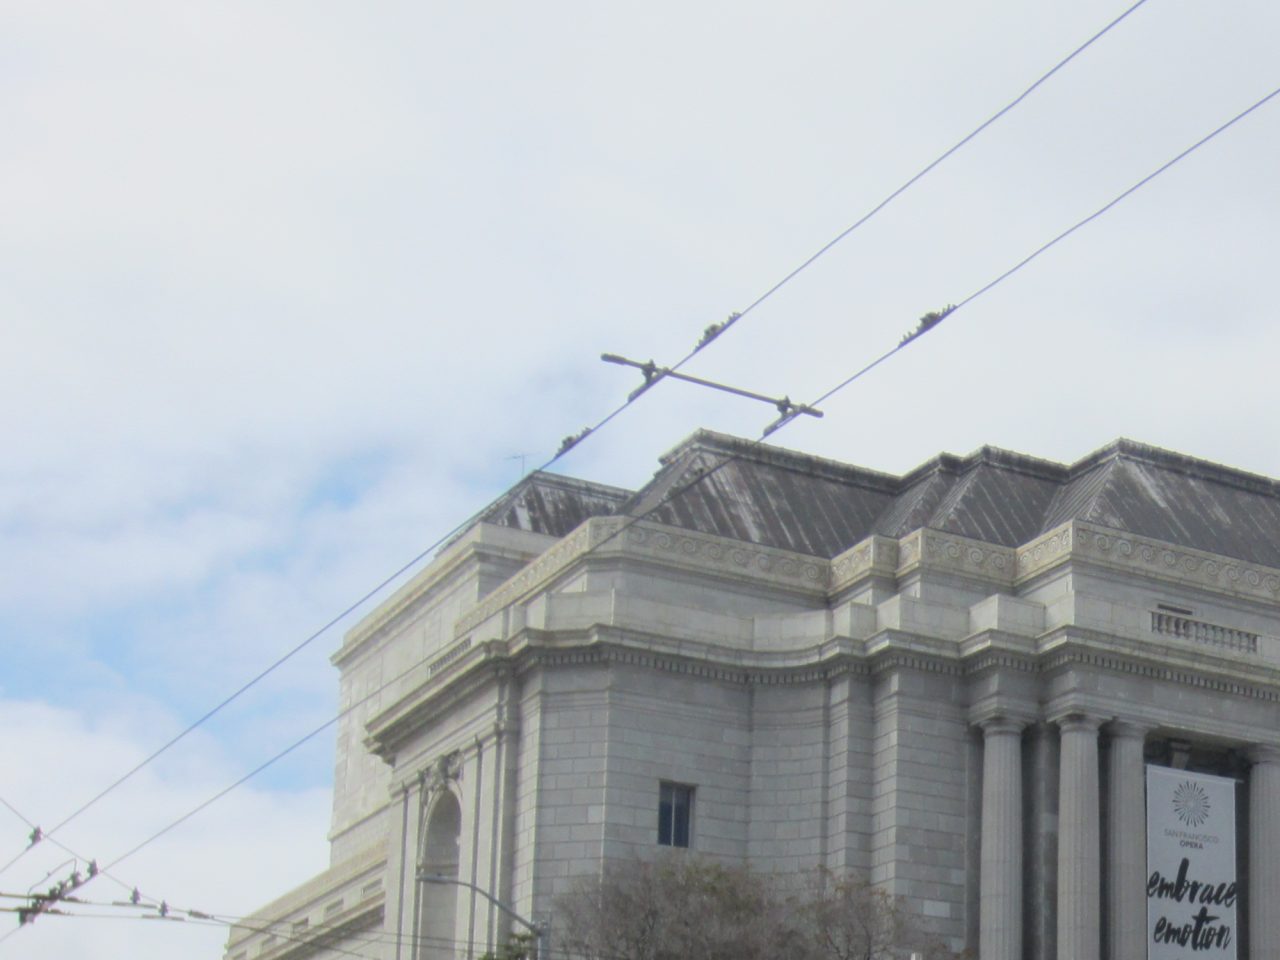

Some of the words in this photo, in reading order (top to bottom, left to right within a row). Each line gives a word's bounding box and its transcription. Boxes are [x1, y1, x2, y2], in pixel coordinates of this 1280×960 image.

[1179, 840, 1204, 850] OPERA
[1147, 857, 1237, 908] embrace
[1153, 906, 1231, 951] emotion
